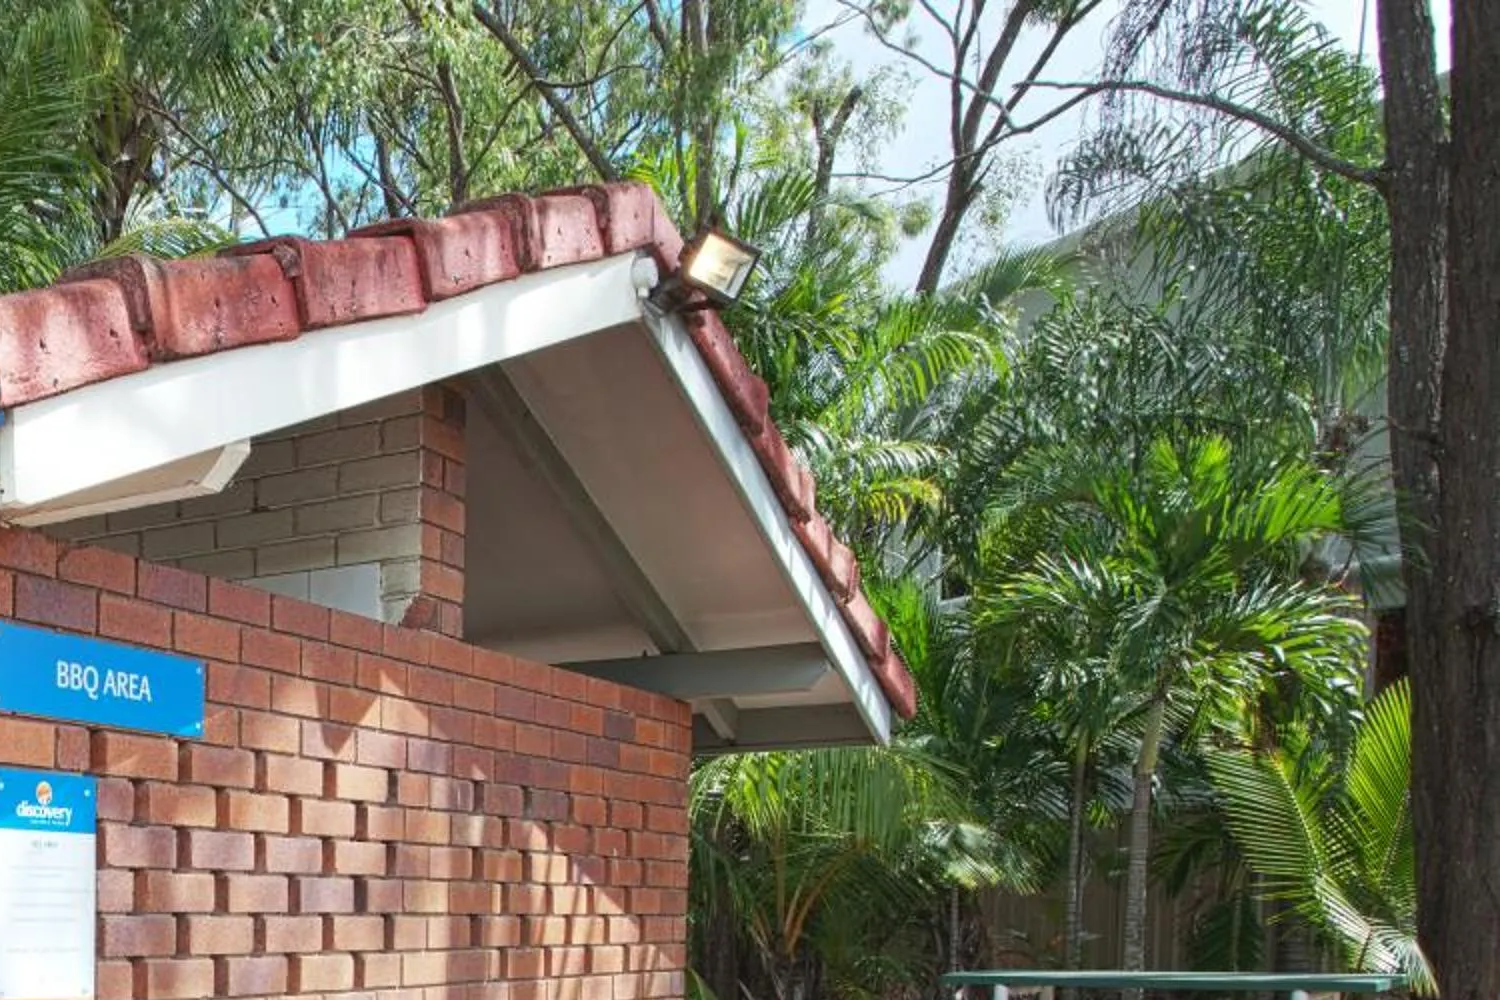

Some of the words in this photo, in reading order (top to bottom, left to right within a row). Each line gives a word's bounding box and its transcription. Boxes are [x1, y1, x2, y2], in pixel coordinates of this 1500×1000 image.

[56, 660, 100, 700] BBQ
[103, 668, 153, 703] AREA
[16, 800, 72, 827] discovery
